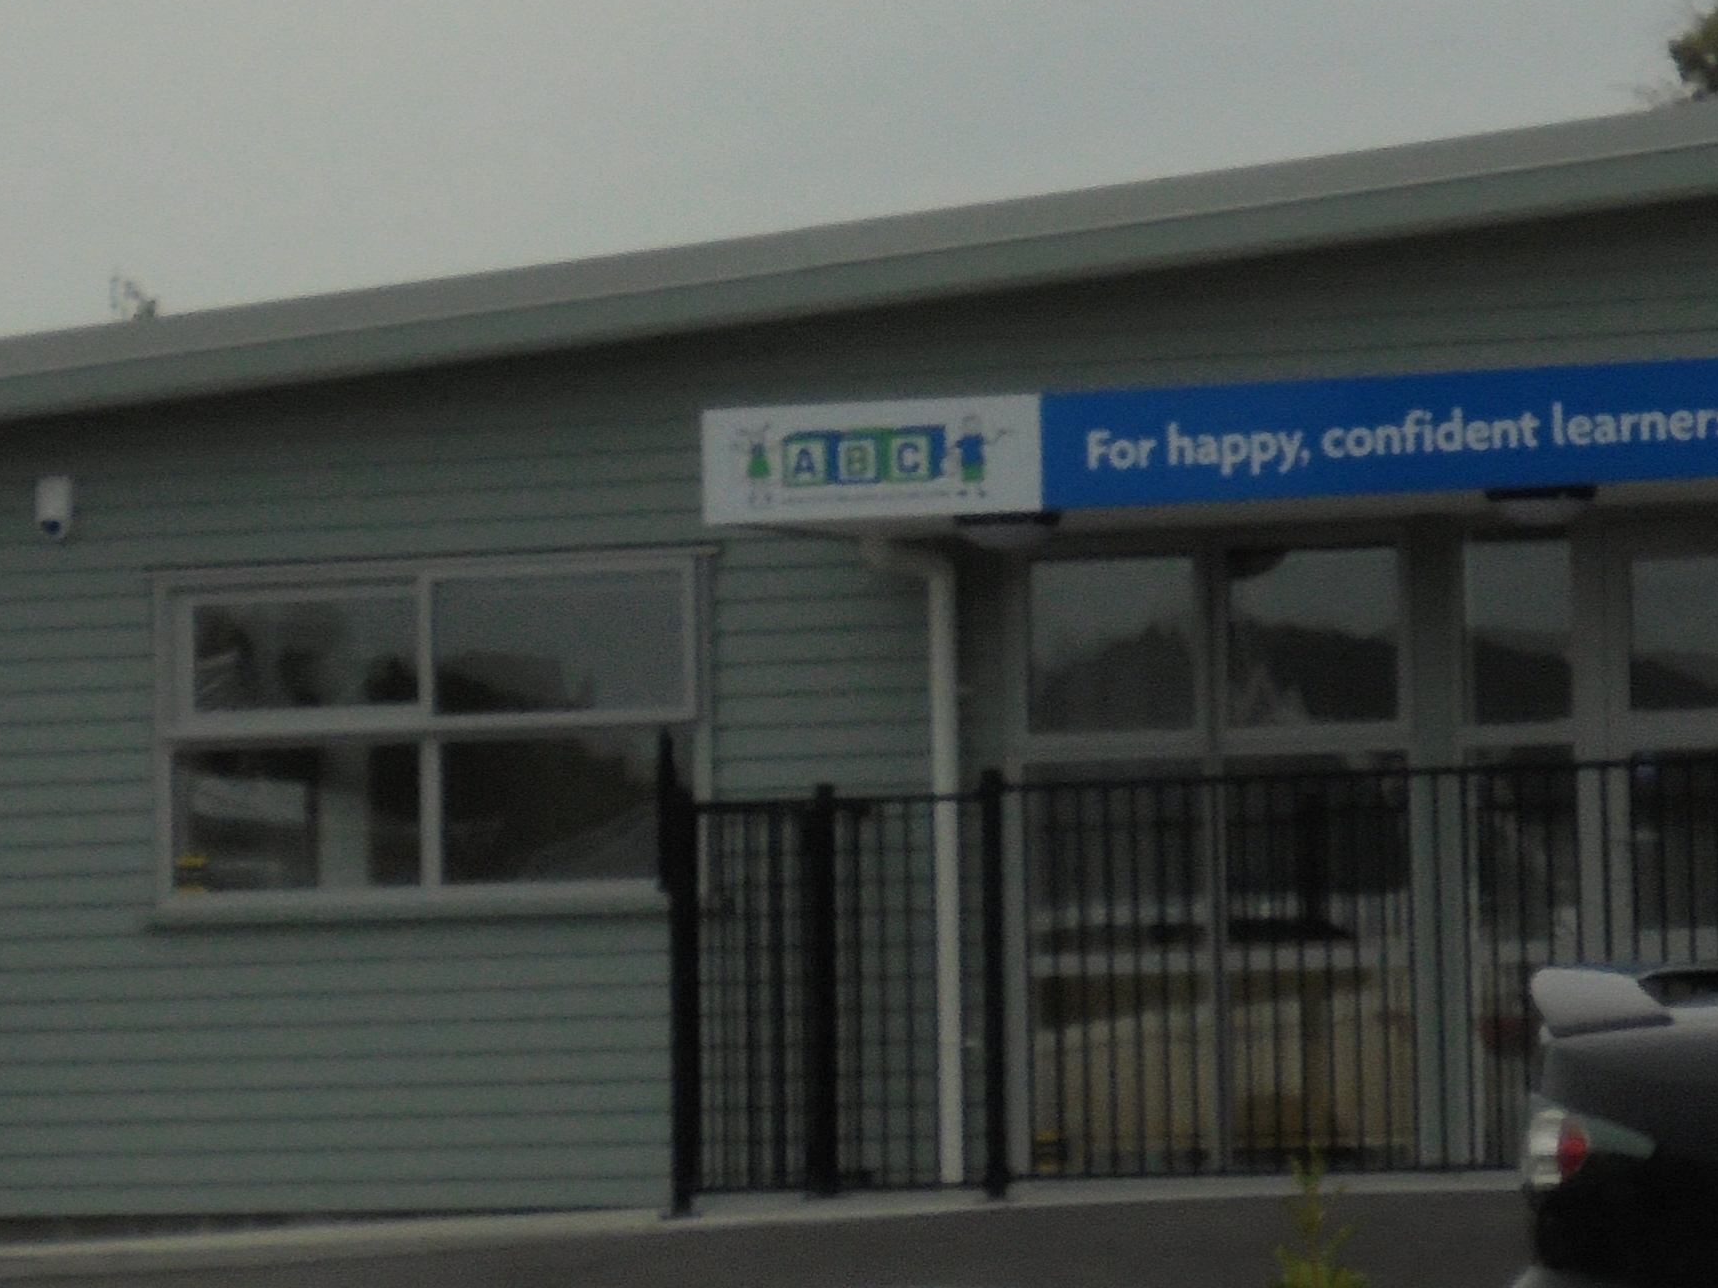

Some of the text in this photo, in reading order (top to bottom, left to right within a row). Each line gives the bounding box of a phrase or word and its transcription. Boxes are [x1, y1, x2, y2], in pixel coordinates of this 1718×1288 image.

[1086, 428, 1157, 471] For
[1167, 421, 1311, 476] happy,
[1321, 406, 1541, 458] confident
